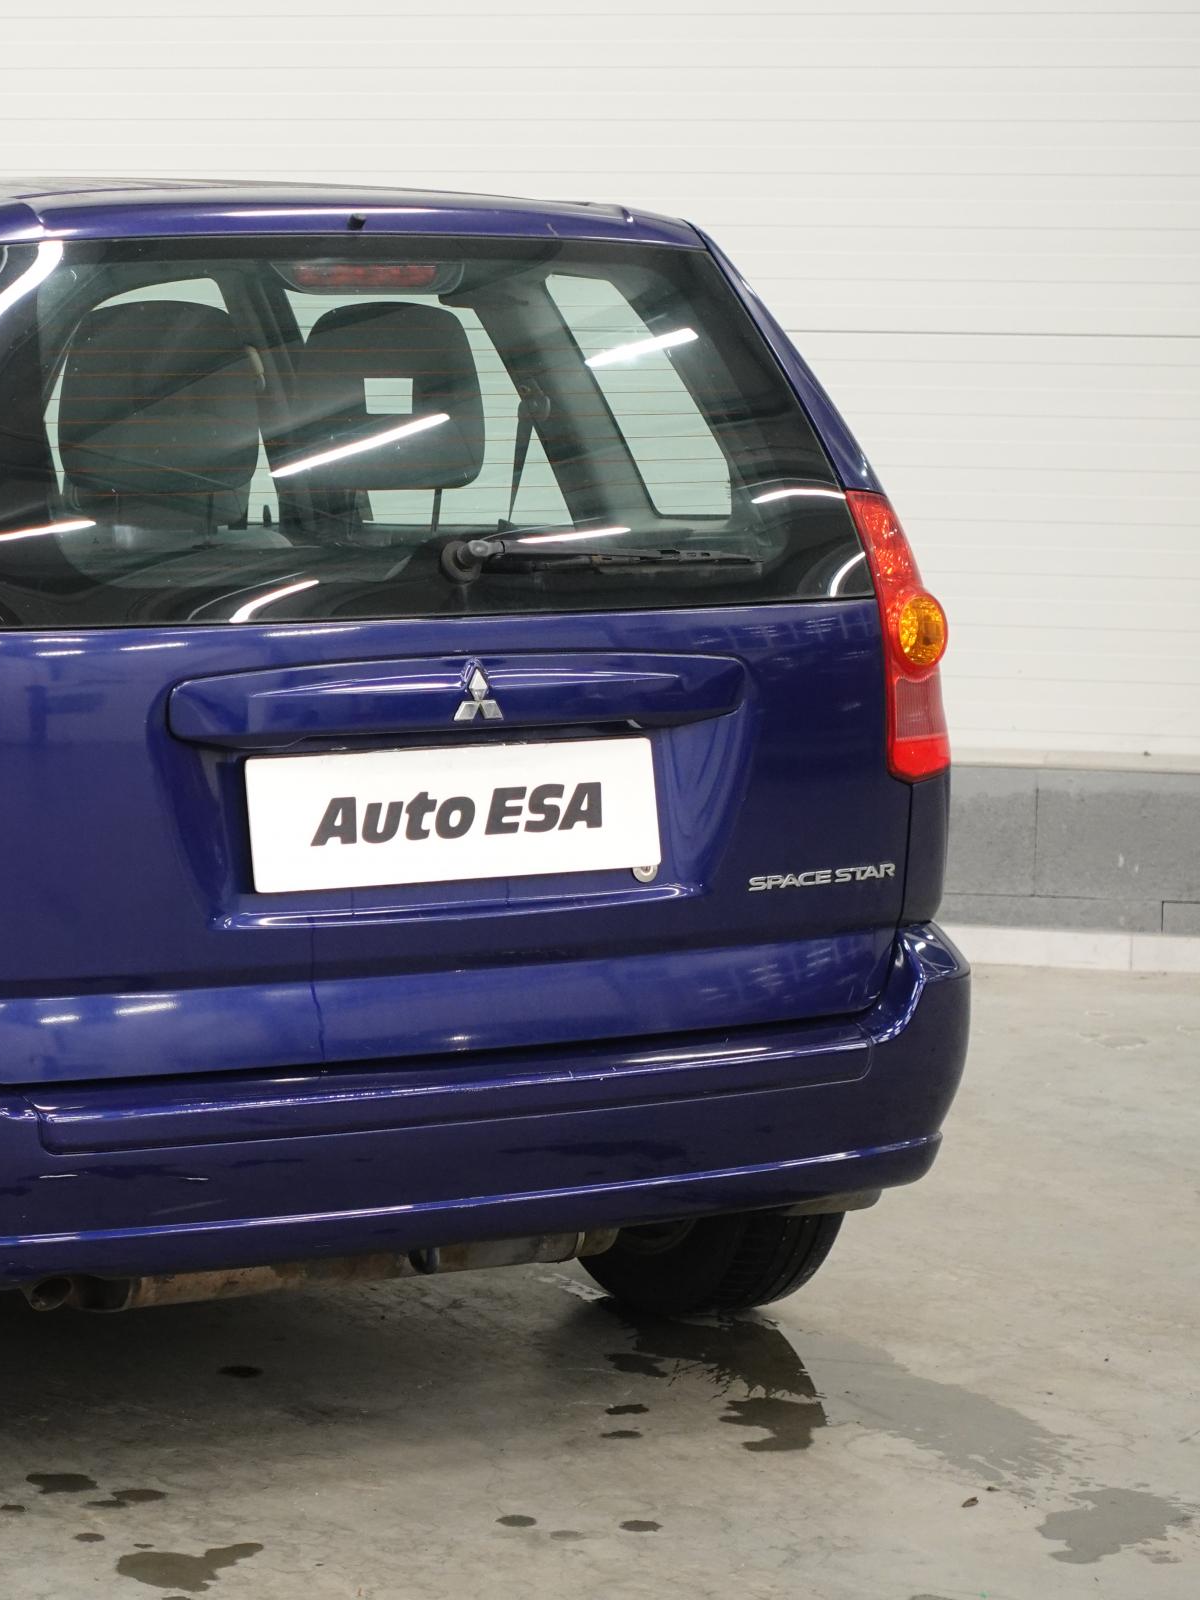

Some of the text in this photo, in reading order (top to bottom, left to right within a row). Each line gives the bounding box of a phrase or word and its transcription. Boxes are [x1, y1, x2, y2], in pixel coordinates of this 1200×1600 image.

[310, 781, 603, 847] Auto ESA
[748, 862, 896, 892] SPACE STAR
